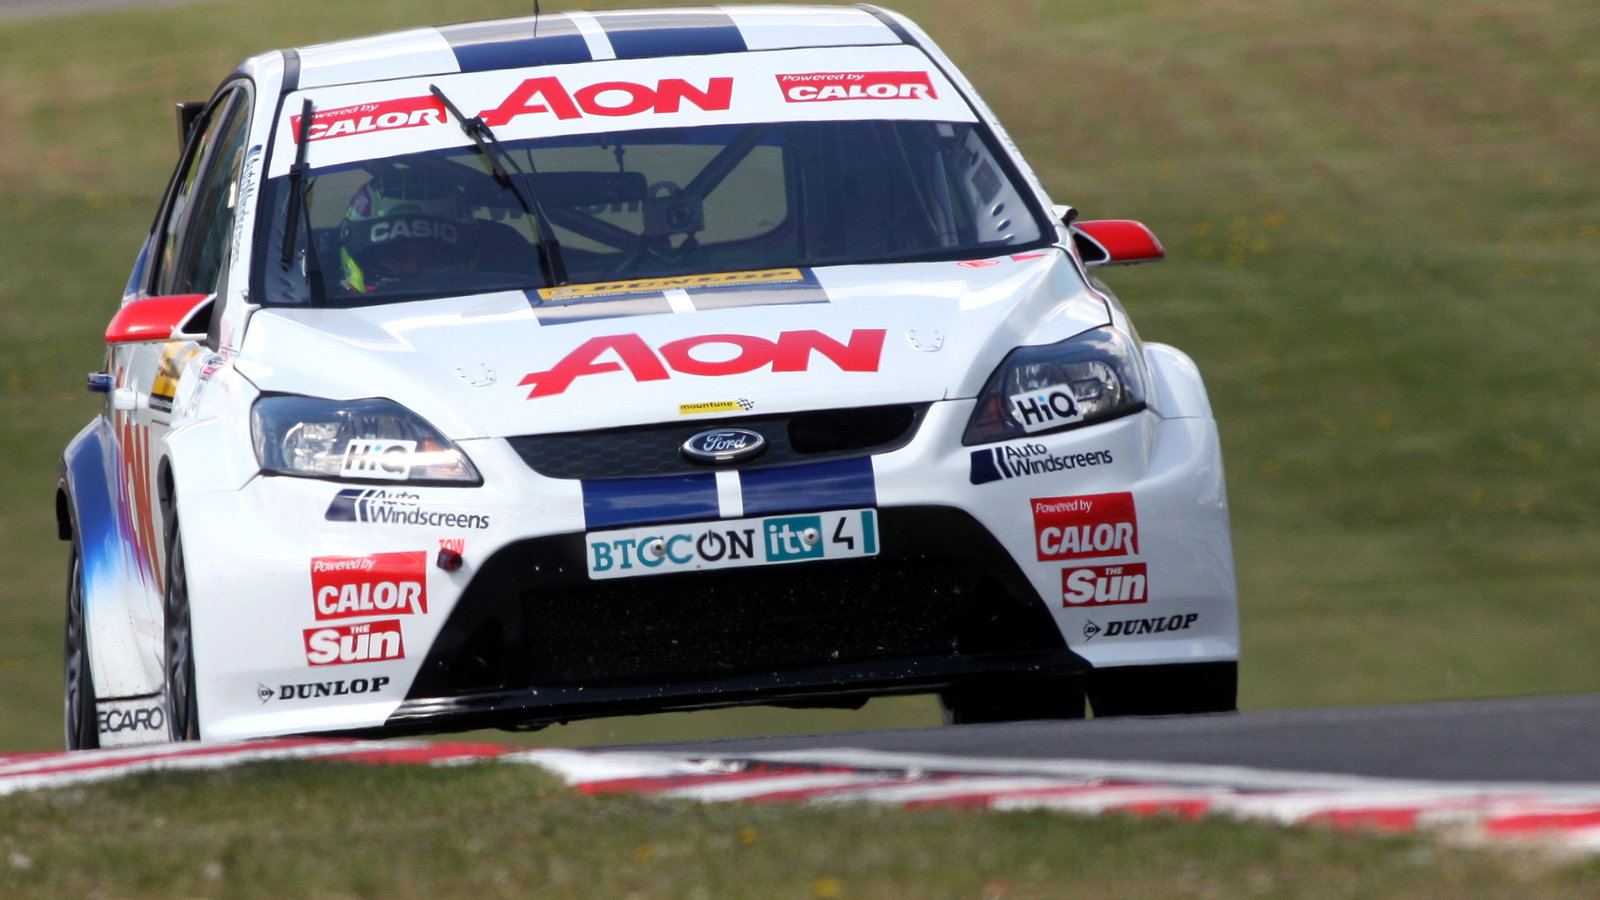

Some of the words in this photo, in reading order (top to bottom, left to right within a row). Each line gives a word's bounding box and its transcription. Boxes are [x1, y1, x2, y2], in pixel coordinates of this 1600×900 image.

[782, 74, 844, 82] Powered
[478, 77, 733, 127] AON
[788, 83, 939, 100] CALOR
[359, 104, 379, 112] by
[307, 108, 447, 139] CALOR
[370, 219, 458, 243] CASIO
[516, 328, 887, 400] AON
[680, 402, 733, 410] mountune
[1016, 392, 1078, 425] HiQ
[703, 433, 746, 451] Ford
[1006, 443, 1047, 459] Auto
[1009, 450, 1113, 478] Windscreens
[371, 490, 420, 506] Auto
[1035, 500, 1078, 513] Powered
[1080, 500, 1092, 513] by
[370, 505, 490, 529] Windscreens
[769, 524, 820, 555] itv
[832, 517, 854, 550] 4
[1039, 522, 1139, 555] CALOR
[313, 559, 364, 573] Powered
[363, 558, 376, 571] by
[1105, 567, 1124, 575] THE
[317, 581, 428, 615] CALOR
[1063, 569, 1146, 604] Sun
[350, 624, 370, 633] THE
[1103, 613, 1199, 637] DUNLOP
[307, 629, 400, 664] Sun
[279, 676, 390, 700] DUNLOP
